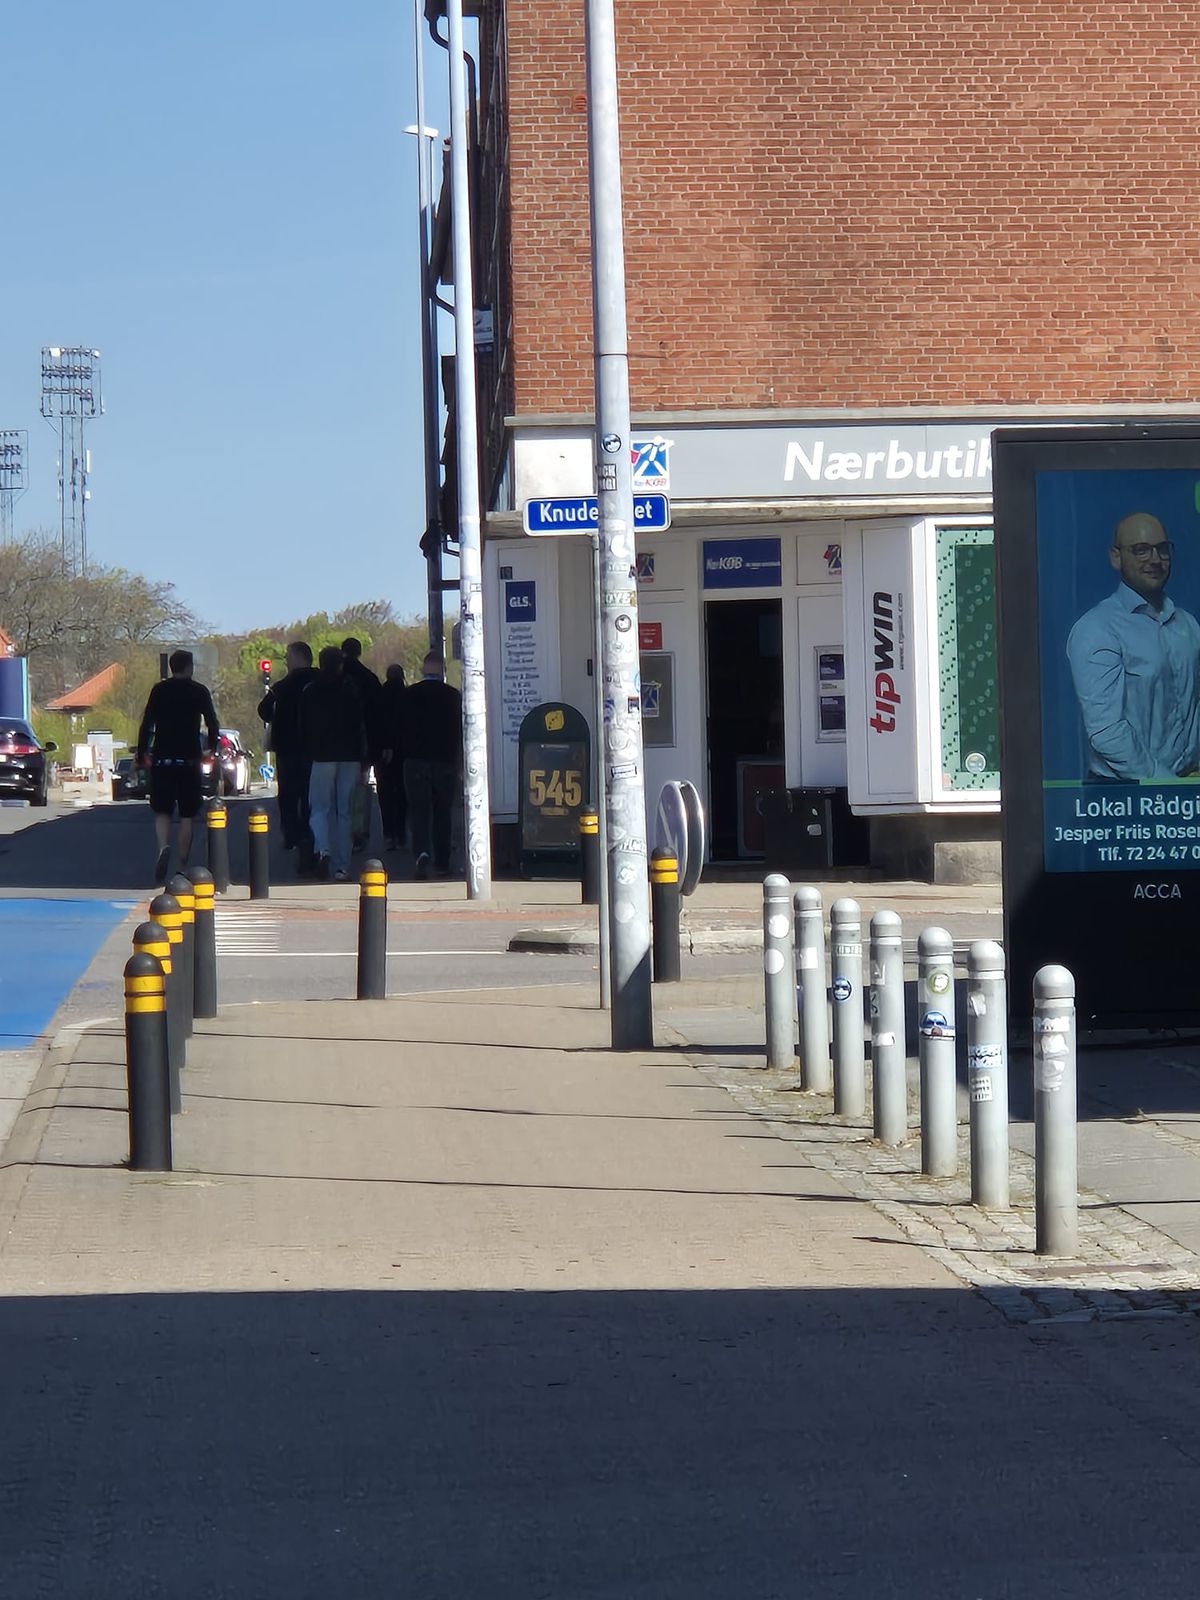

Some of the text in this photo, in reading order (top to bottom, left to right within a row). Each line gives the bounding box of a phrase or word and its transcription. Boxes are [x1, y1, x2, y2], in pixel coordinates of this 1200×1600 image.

[528, 769, 582, 807] 545
[1075, 797, 1132, 816] Lokal
[1055, 826, 1112, 844] Jesper
[1116, 824, 1151, 840] Friis
[1098, 847, 1122, 861] Tlf.
[1126, 847, 1143, 860] 72
[1147, 846, 1166, 860] 24
[1169, 846, 1188, 859] 47
[1134, 884, 1182, 899] ACCA
